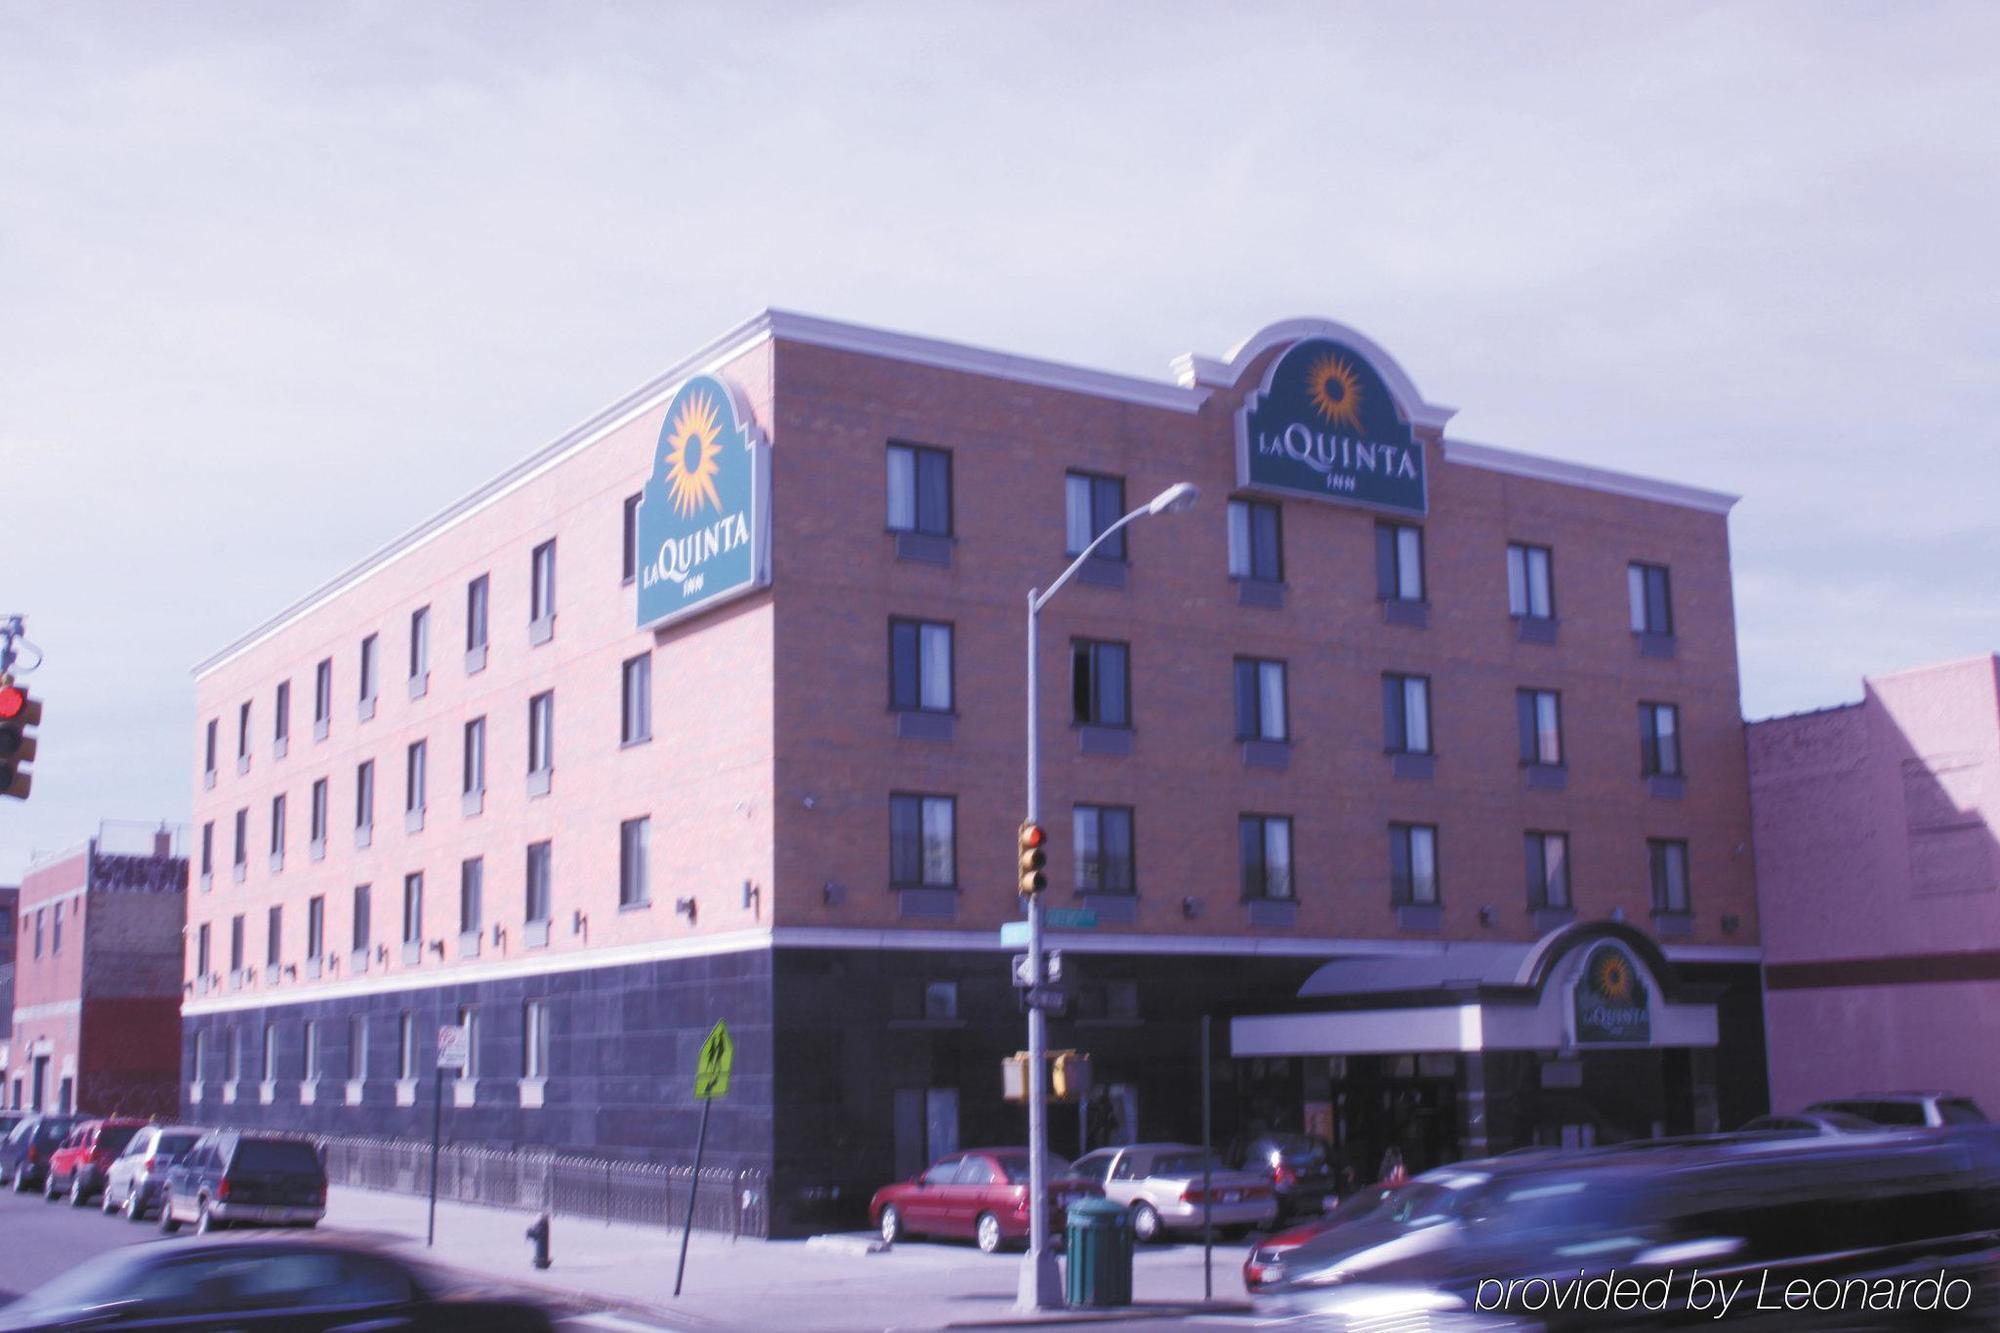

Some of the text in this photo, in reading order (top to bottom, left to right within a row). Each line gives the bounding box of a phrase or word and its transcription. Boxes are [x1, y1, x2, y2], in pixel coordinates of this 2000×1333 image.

[1259, 423, 1417, 479] LA QUINTA
[1327, 473, 1356, 491] INN
[643, 510, 749, 589] LA QUINTA
[683, 573, 704, 597] INN
